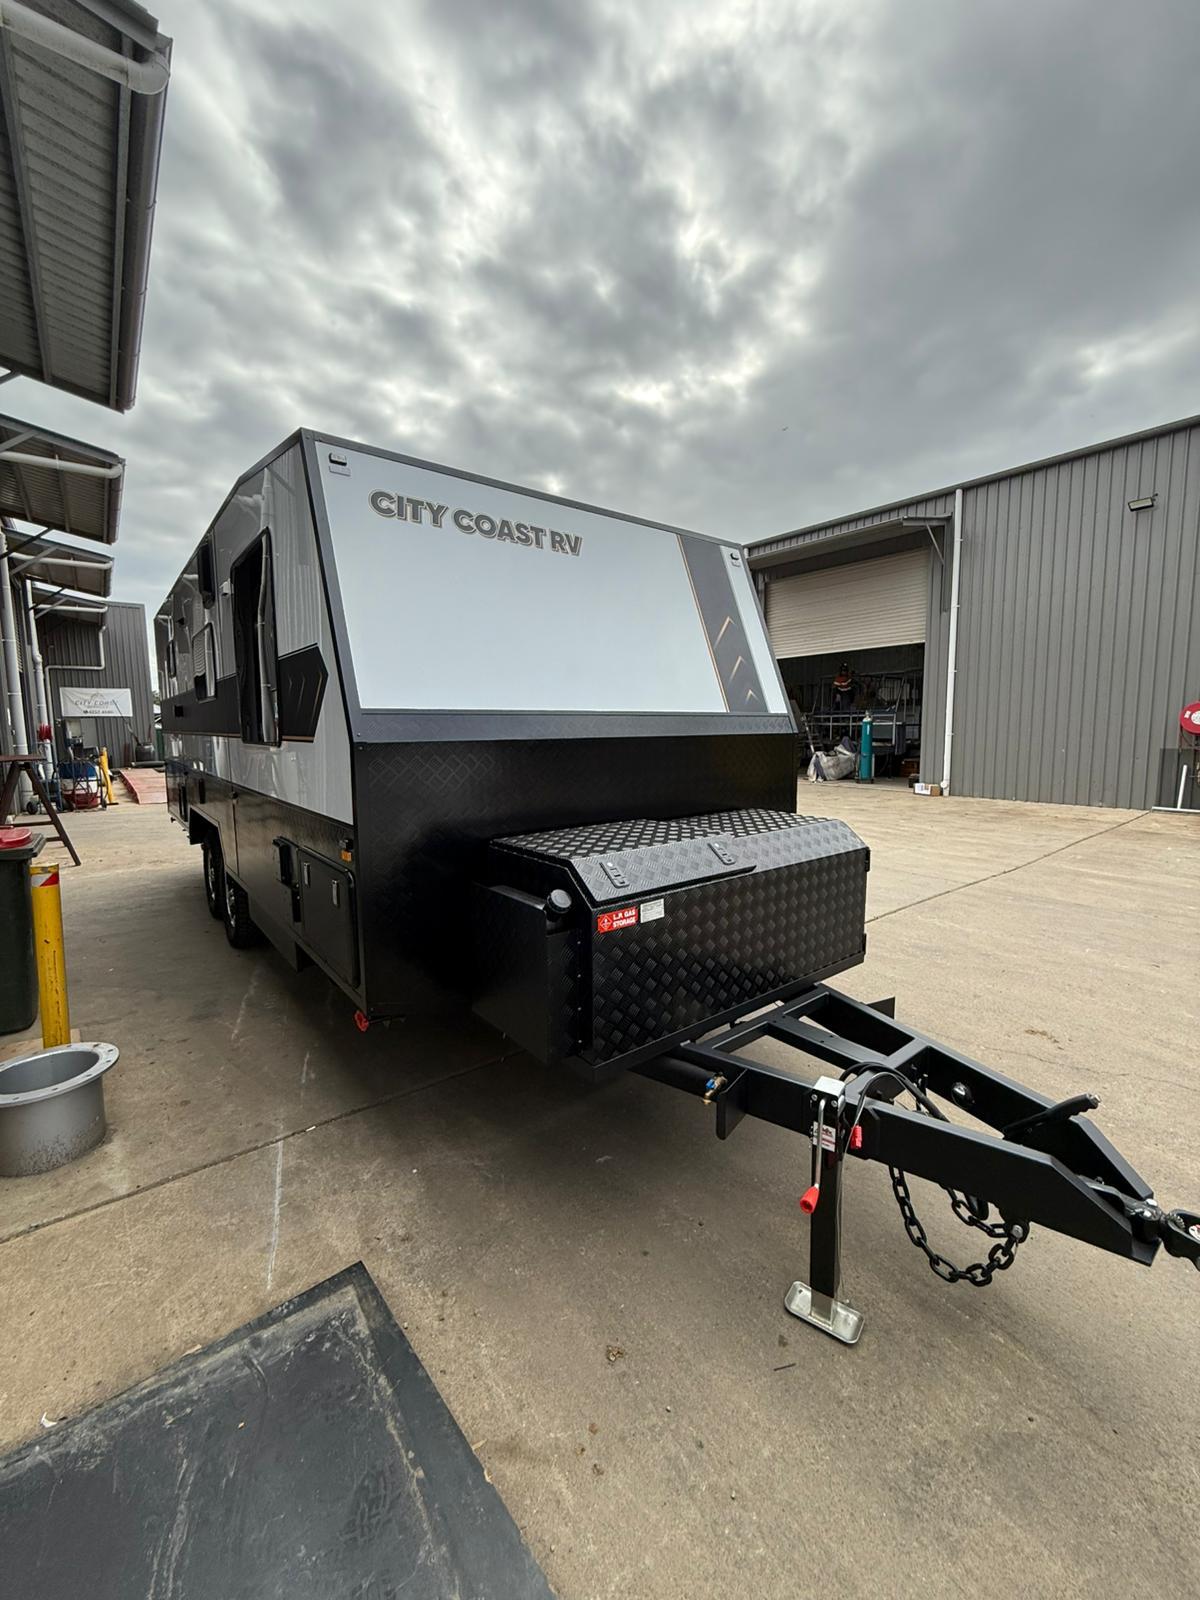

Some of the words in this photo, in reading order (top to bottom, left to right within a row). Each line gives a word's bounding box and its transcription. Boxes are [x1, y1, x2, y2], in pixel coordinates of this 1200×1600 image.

[368, 489, 449, 528] CITY
[452, 508, 546, 549] COAST
[550, 529, 583, 556] RV
[624, 909, 636, 918] GAS
[612, 917, 636, 928] STORAGE
